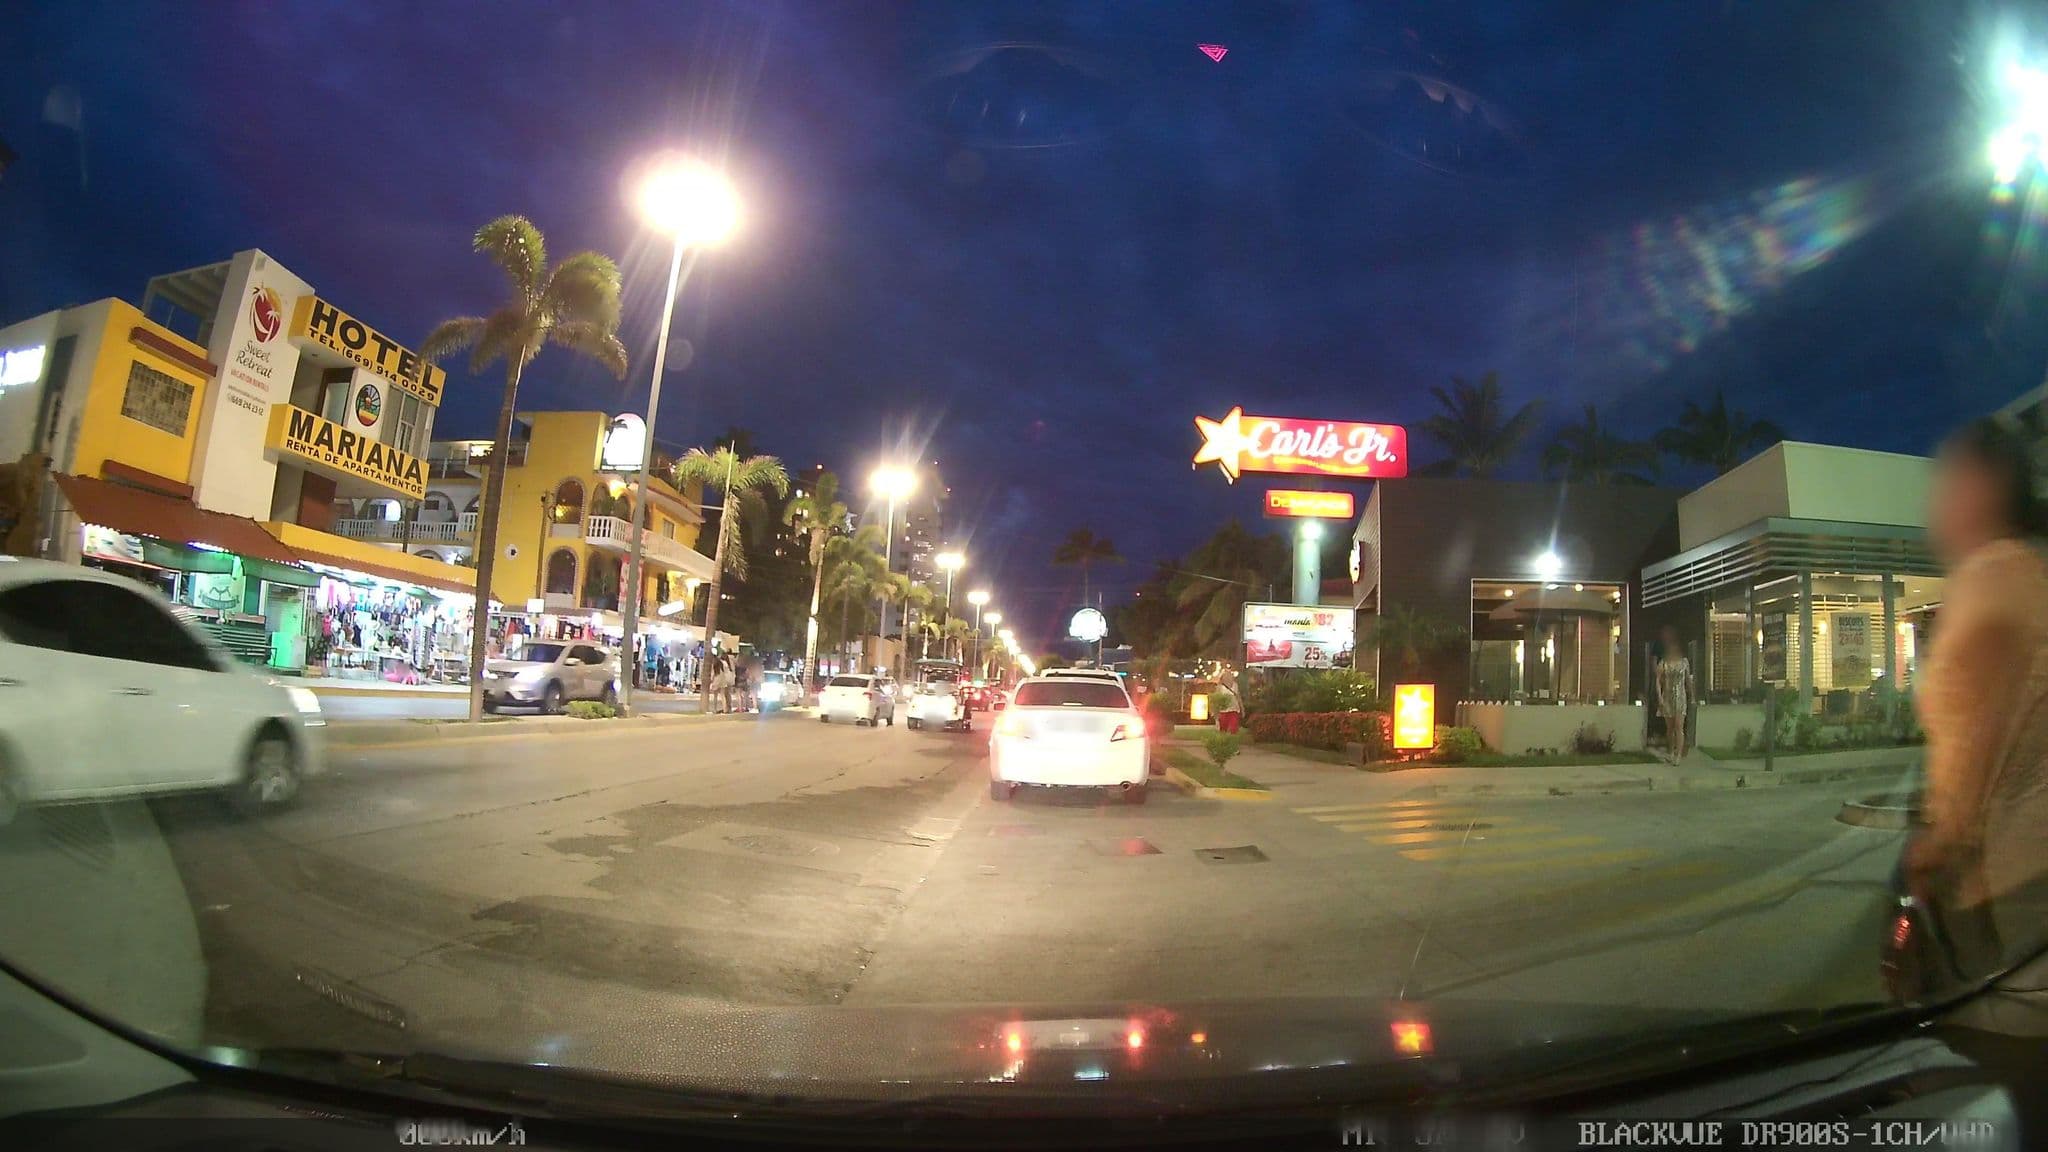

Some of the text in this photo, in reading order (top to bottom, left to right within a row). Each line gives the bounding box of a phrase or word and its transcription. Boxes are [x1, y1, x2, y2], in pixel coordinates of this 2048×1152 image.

[236, 350, 272, 378] Retreat
[244, 340, 271, 363] Sweet
[309, 328, 435, 401] TEL. (669) 914 0029
[310, 299, 439, 395] HOTEL
[286, 439, 423, 495] RENTA DE APARTAMENTOS
[288, 409, 423, 485] MARIANA
[1248, 420, 1397, 465] Carl's Jr.
